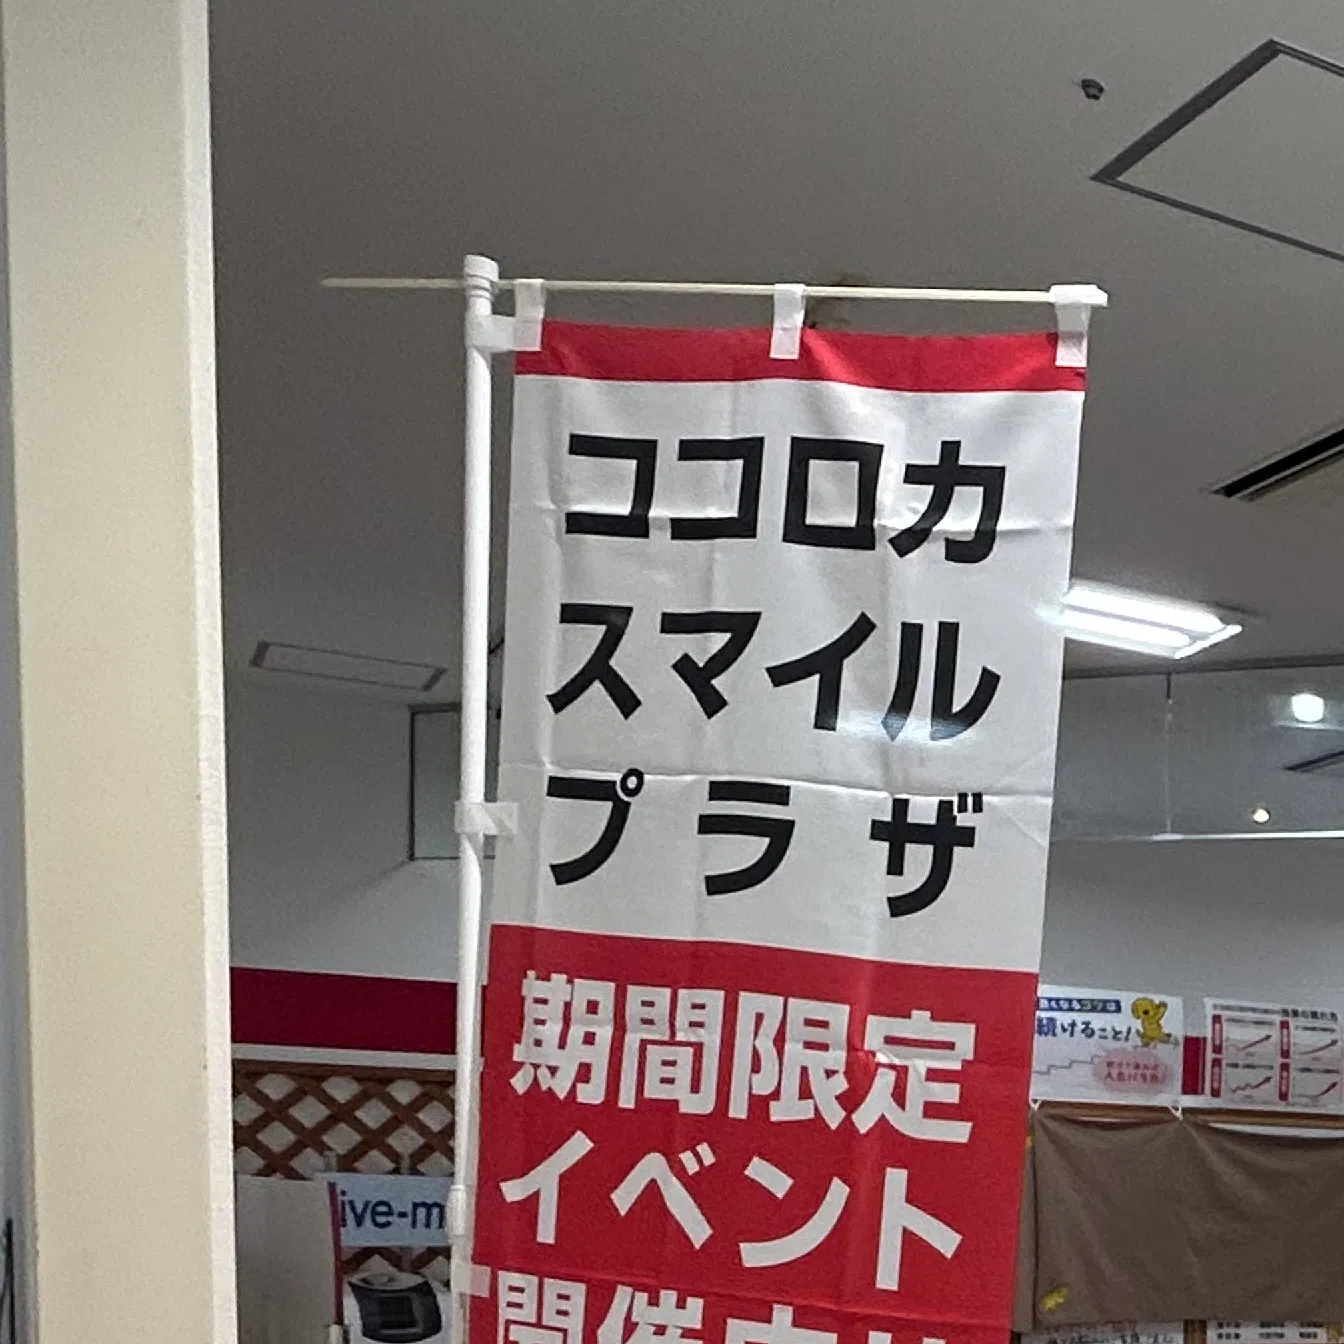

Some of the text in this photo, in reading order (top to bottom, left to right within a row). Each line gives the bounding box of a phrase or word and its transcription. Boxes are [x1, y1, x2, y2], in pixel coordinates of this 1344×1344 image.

[565, 434, 1006, 563] ココロカ
[546, 602, 1000, 741] スマイル
[547, 768, 983, 917] プラザ
[510, 971, 975, 1143] 期間限定
[500, 1130, 962, 1292] イベント
